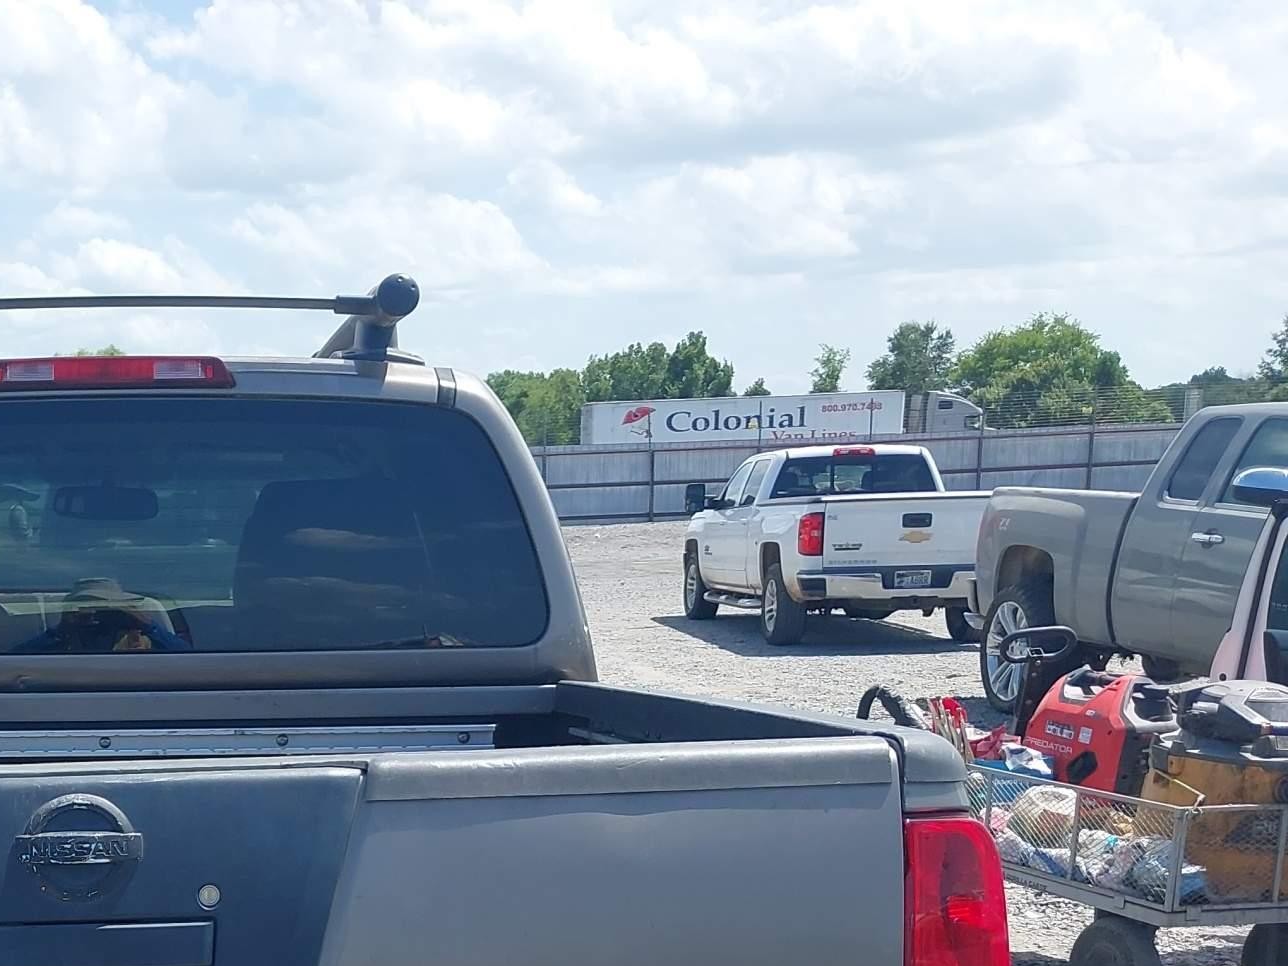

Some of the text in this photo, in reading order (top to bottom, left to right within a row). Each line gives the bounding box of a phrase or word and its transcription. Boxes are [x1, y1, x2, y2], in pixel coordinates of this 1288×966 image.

[666, 406, 806, 432] Colonial
[772, 430, 804, 440] Van
[1024, 735, 1073, 755] PREDATOR
[28, 839, 129, 860] NISSAN
